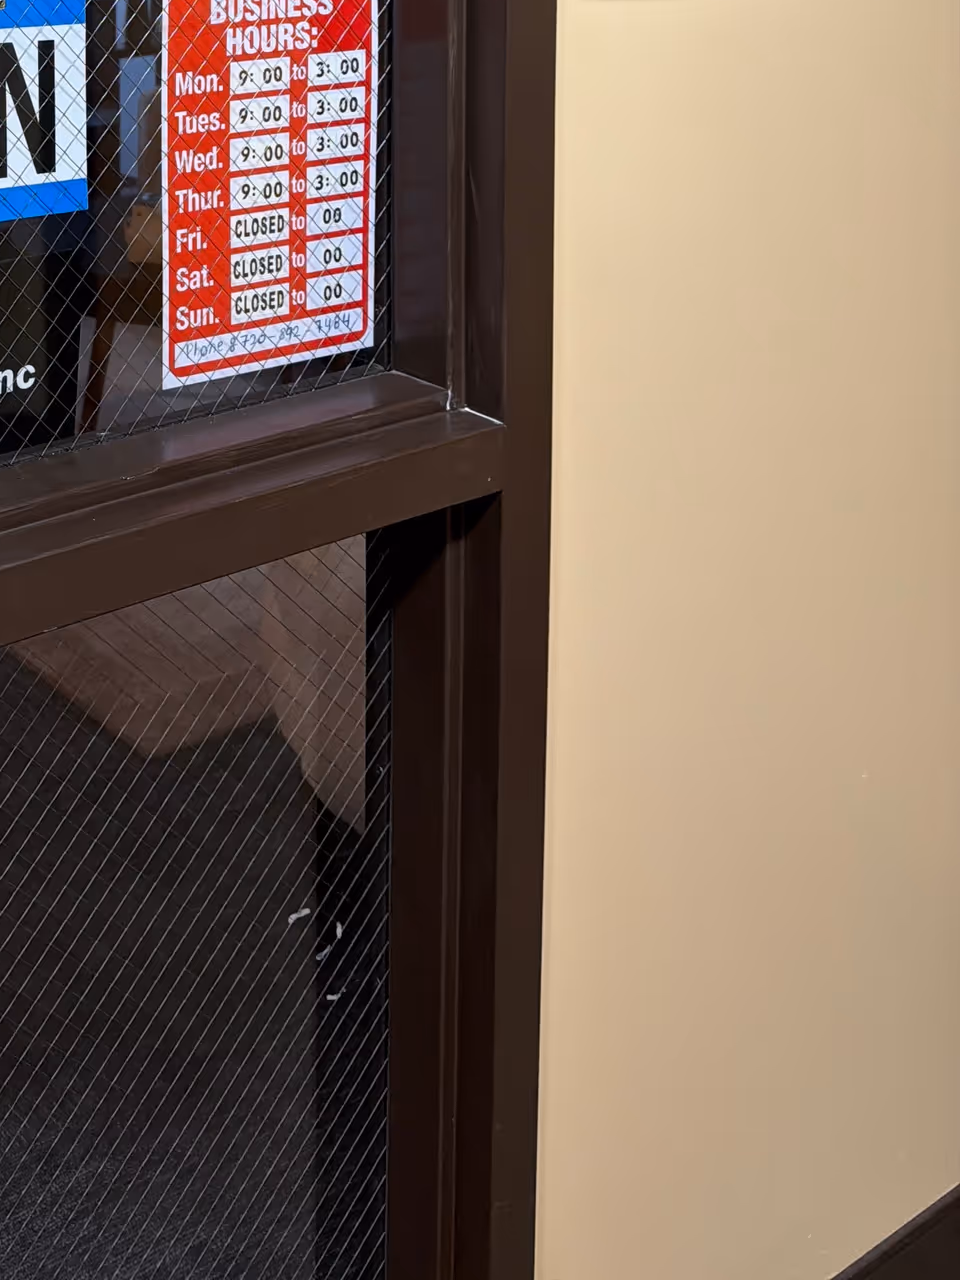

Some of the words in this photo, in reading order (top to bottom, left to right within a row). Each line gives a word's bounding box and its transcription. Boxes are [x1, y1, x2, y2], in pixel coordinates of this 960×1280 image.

[225, 21, 319, 57] HOURS:
[175, 71, 224, 96] Mon.
[292, 63, 307, 81] to
[175, 109, 226, 135] Tues.
[292, 101, 306, 118] to
[175, 146, 224, 174] Wed.
[291, 138, 306, 156] to
[175, 189, 225, 214] Thur.
[291, 176, 306, 193] to
[175, 225, 208, 253] Fri.
[234, 214, 285, 239] CLOSED
[291, 213, 306, 231] to
[323, 207, 342, 225] 00
[175, 265, 215, 292] Sat.
[233, 254, 283, 280] CLOSED
[291, 251, 306, 268] to
[323, 247, 342, 265] 00
[175, 305, 220, 331] Sun.
[234, 290, 285, 315] CLOSED
[291, 289, 306, 306] to
[323, 283, 343, 301] 00
